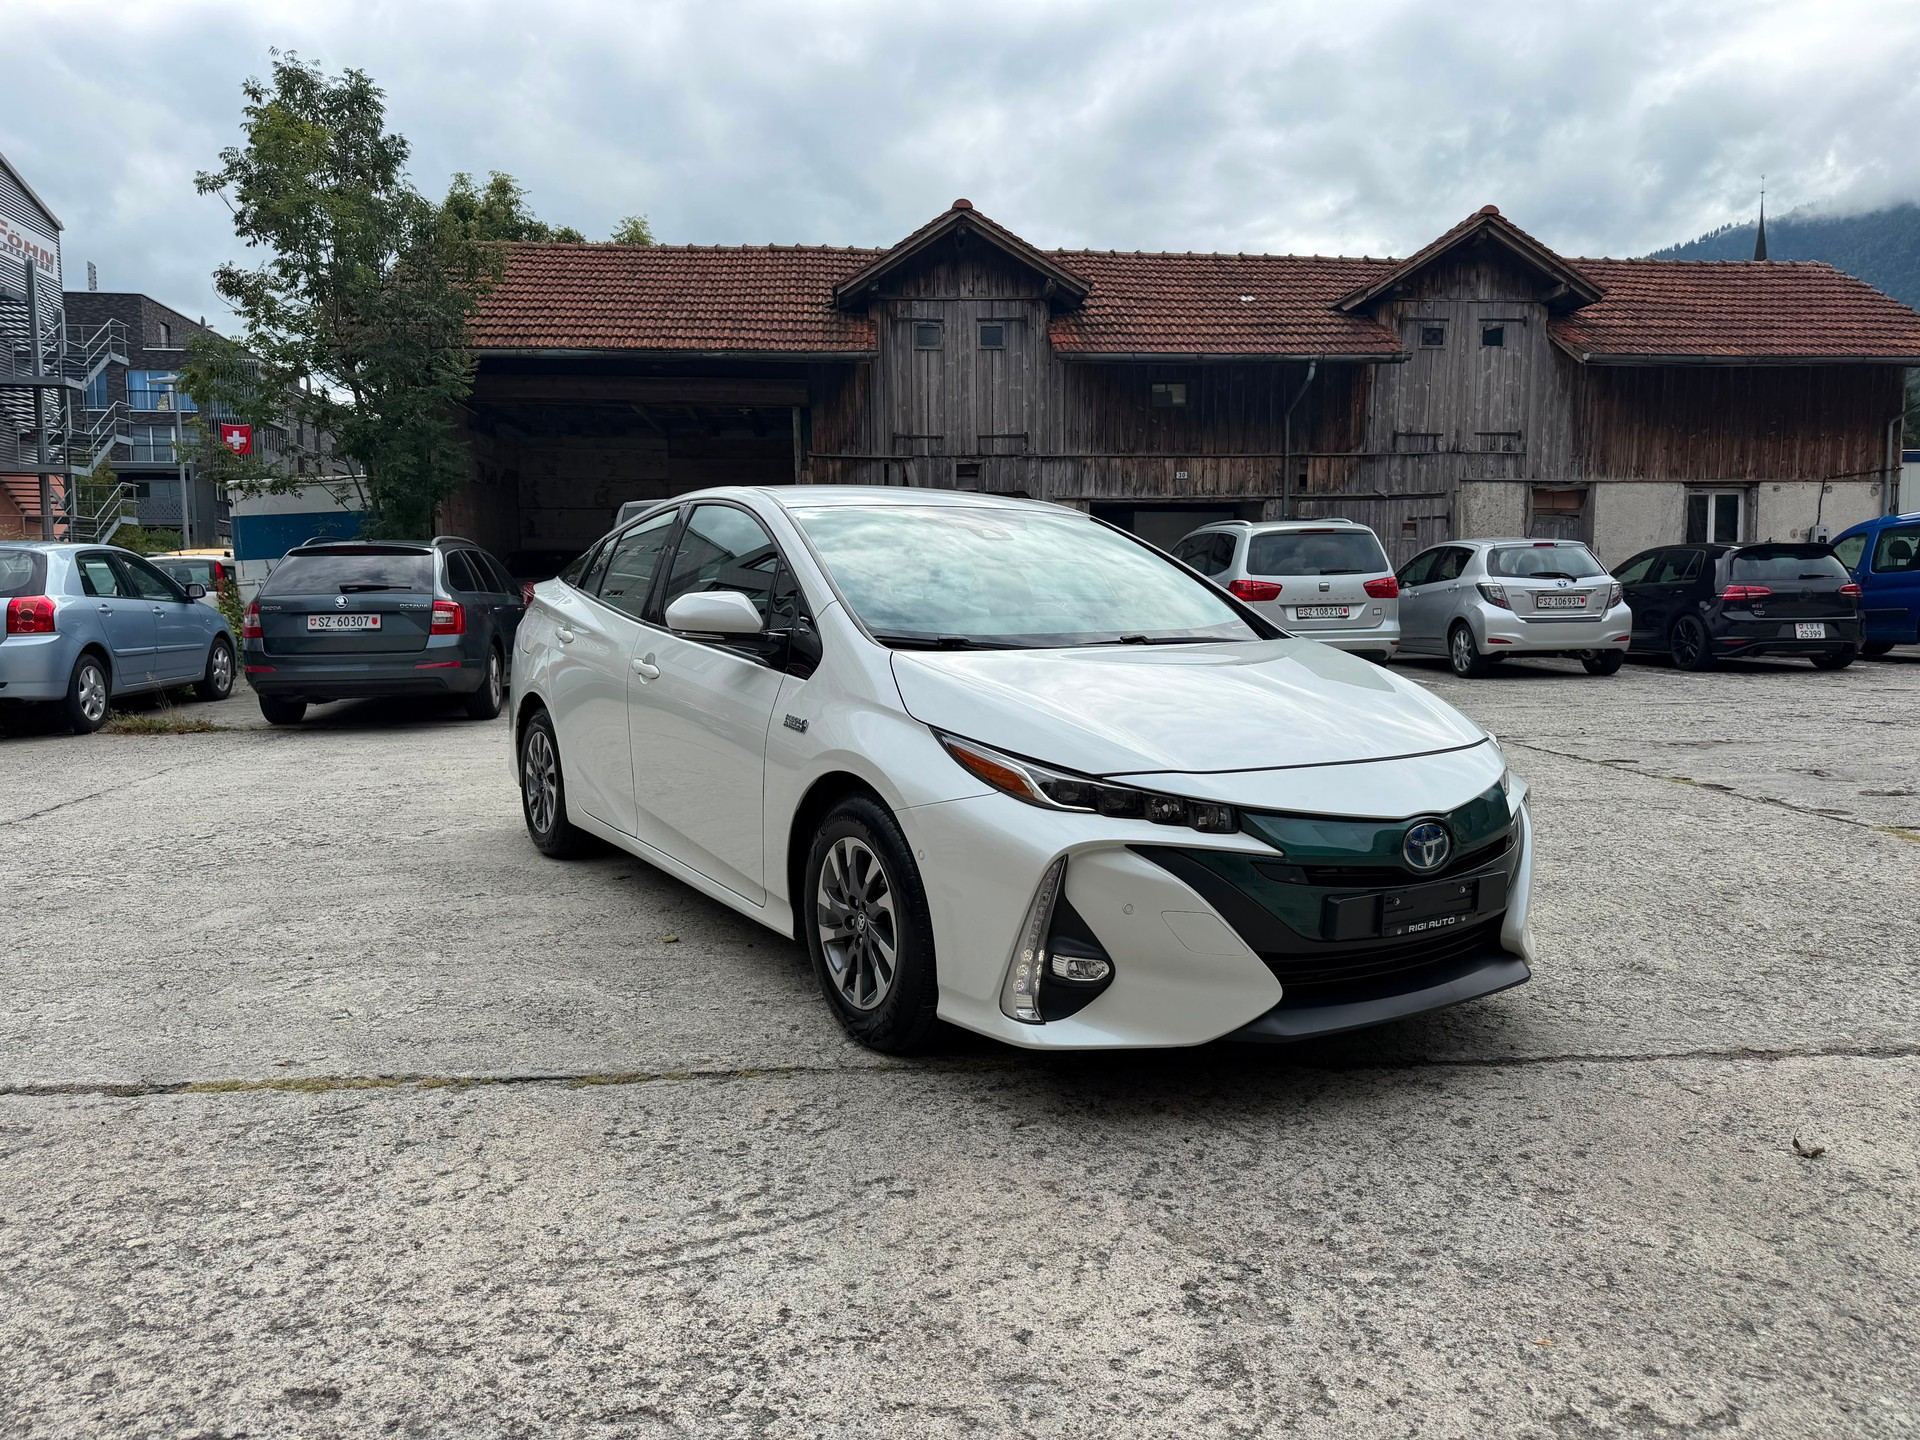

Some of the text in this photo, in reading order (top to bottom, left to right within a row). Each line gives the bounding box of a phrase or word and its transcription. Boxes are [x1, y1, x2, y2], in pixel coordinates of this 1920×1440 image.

[1800, 630, 1822, 638] 25399
[1408, 916, 1455, 933] RIGI AUTO
